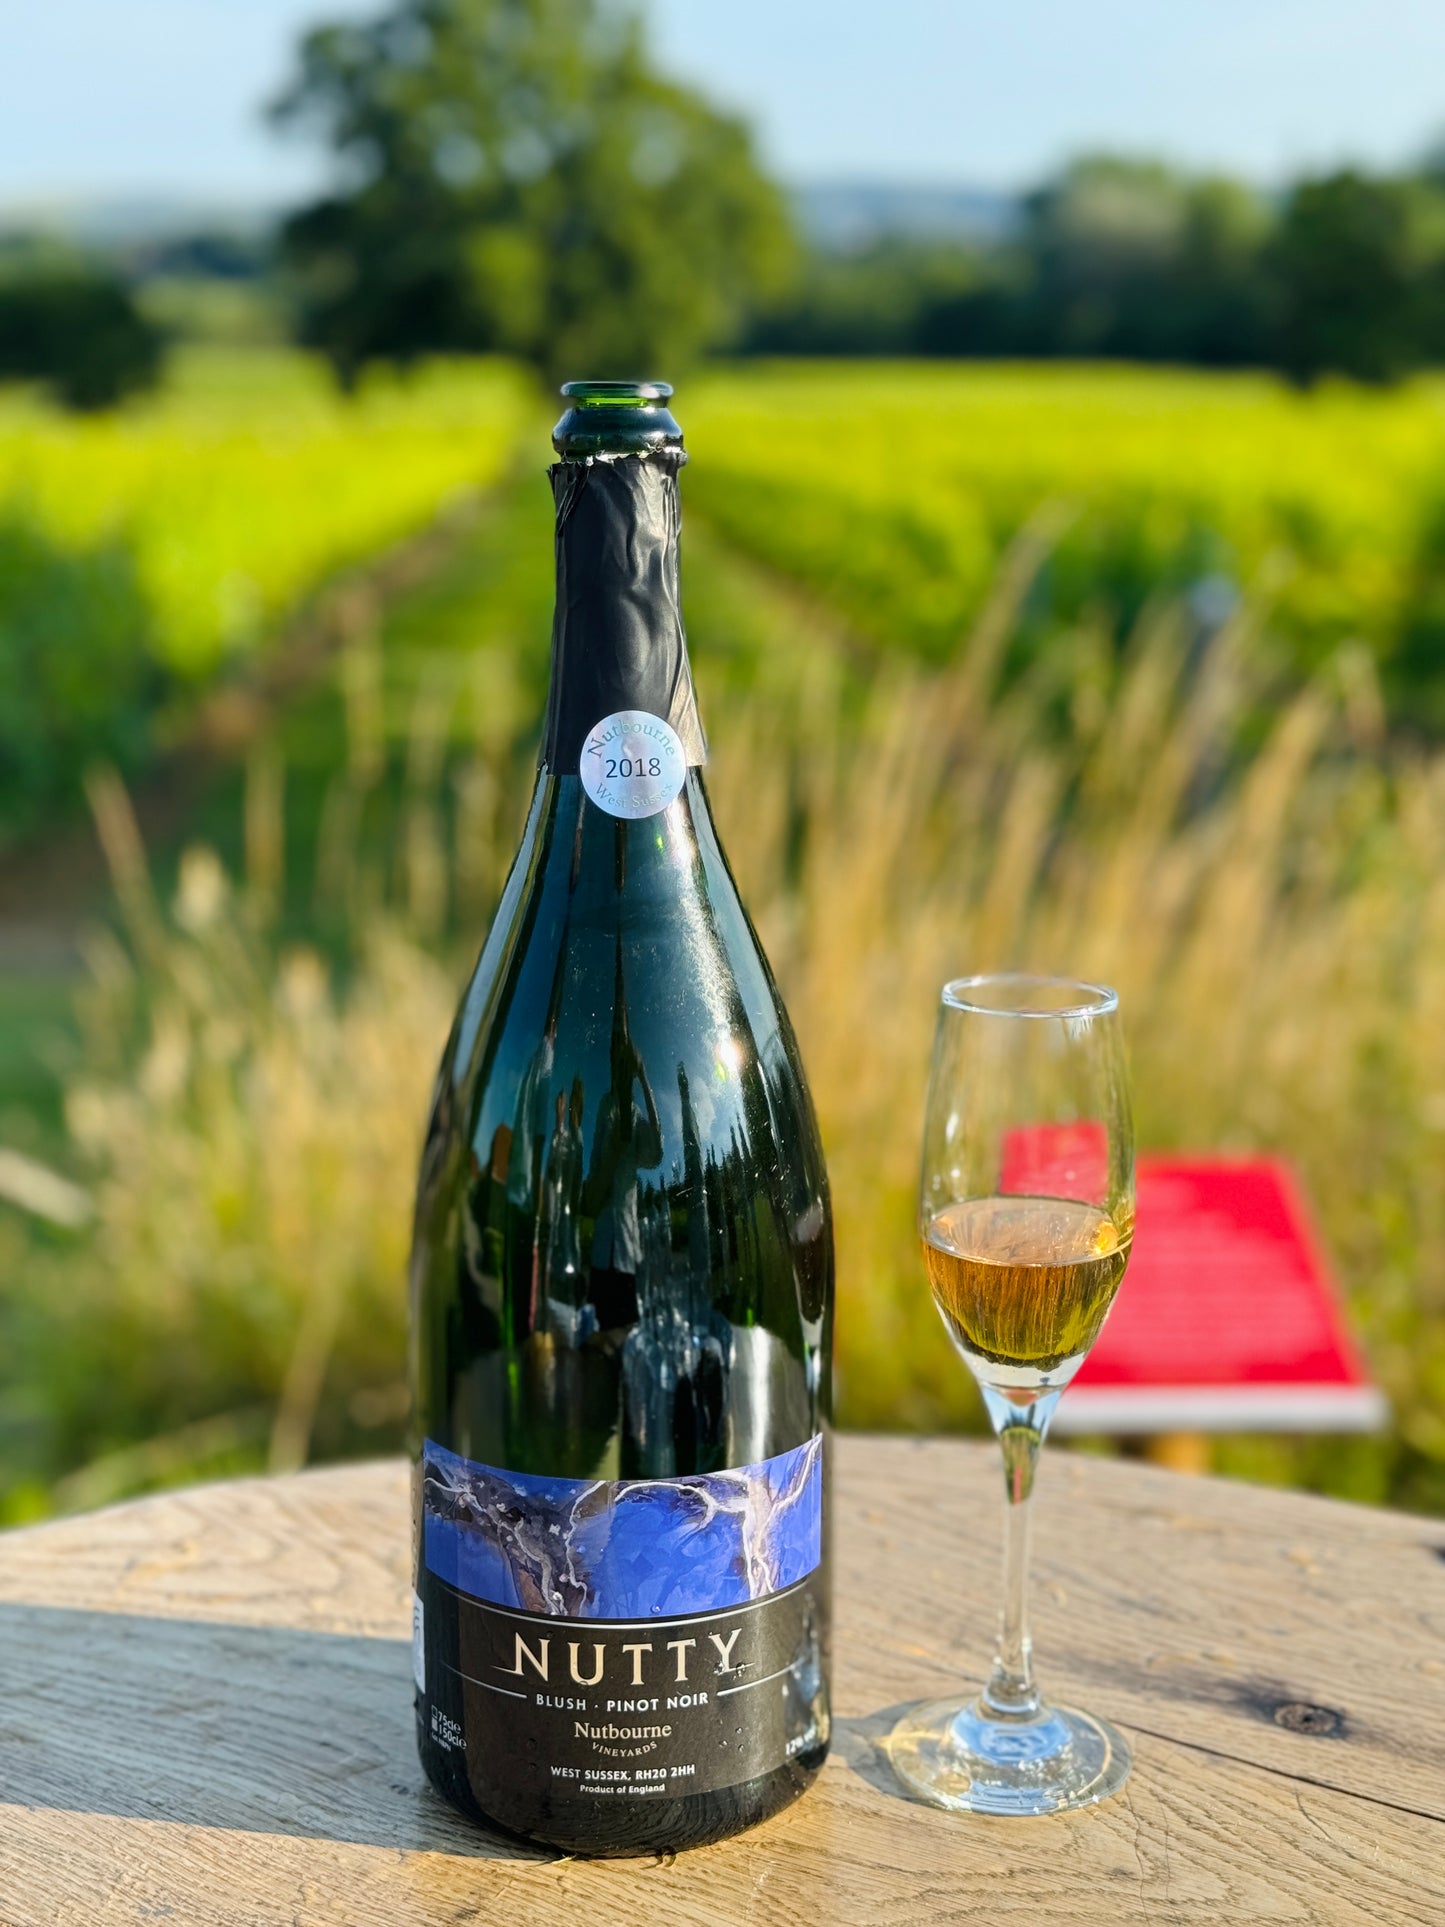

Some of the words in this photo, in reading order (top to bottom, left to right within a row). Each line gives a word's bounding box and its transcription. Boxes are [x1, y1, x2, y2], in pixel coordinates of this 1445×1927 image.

[587, 720, 675, 759] Nutbourne
[605, 757, 661, 778] 2018
[596, 782, 628, 808] West
[490, 1628, 755, 1686] NUTTY
[536, 1693, 587, 1711] BLUSH
[606, 1699, 659, 1712] PINOT
[666, 1692, 709, 1710] NOIR
[574, 1721, 673, 1740] Nutbourne
[592, 1740, 659, 1758] VINEYARDS
[550, 1765, 582, 1779] WEST
[584, 1769, 632, 1781] SUSSEX,
[635, 1767, 668, 1780] RH20
[670, 1764, 696, 1777] 2HH
[579, 1784, 614, 1793] Product
[616, 1784, 627, 1794] of
[628, 1783, 666, 1795] England
